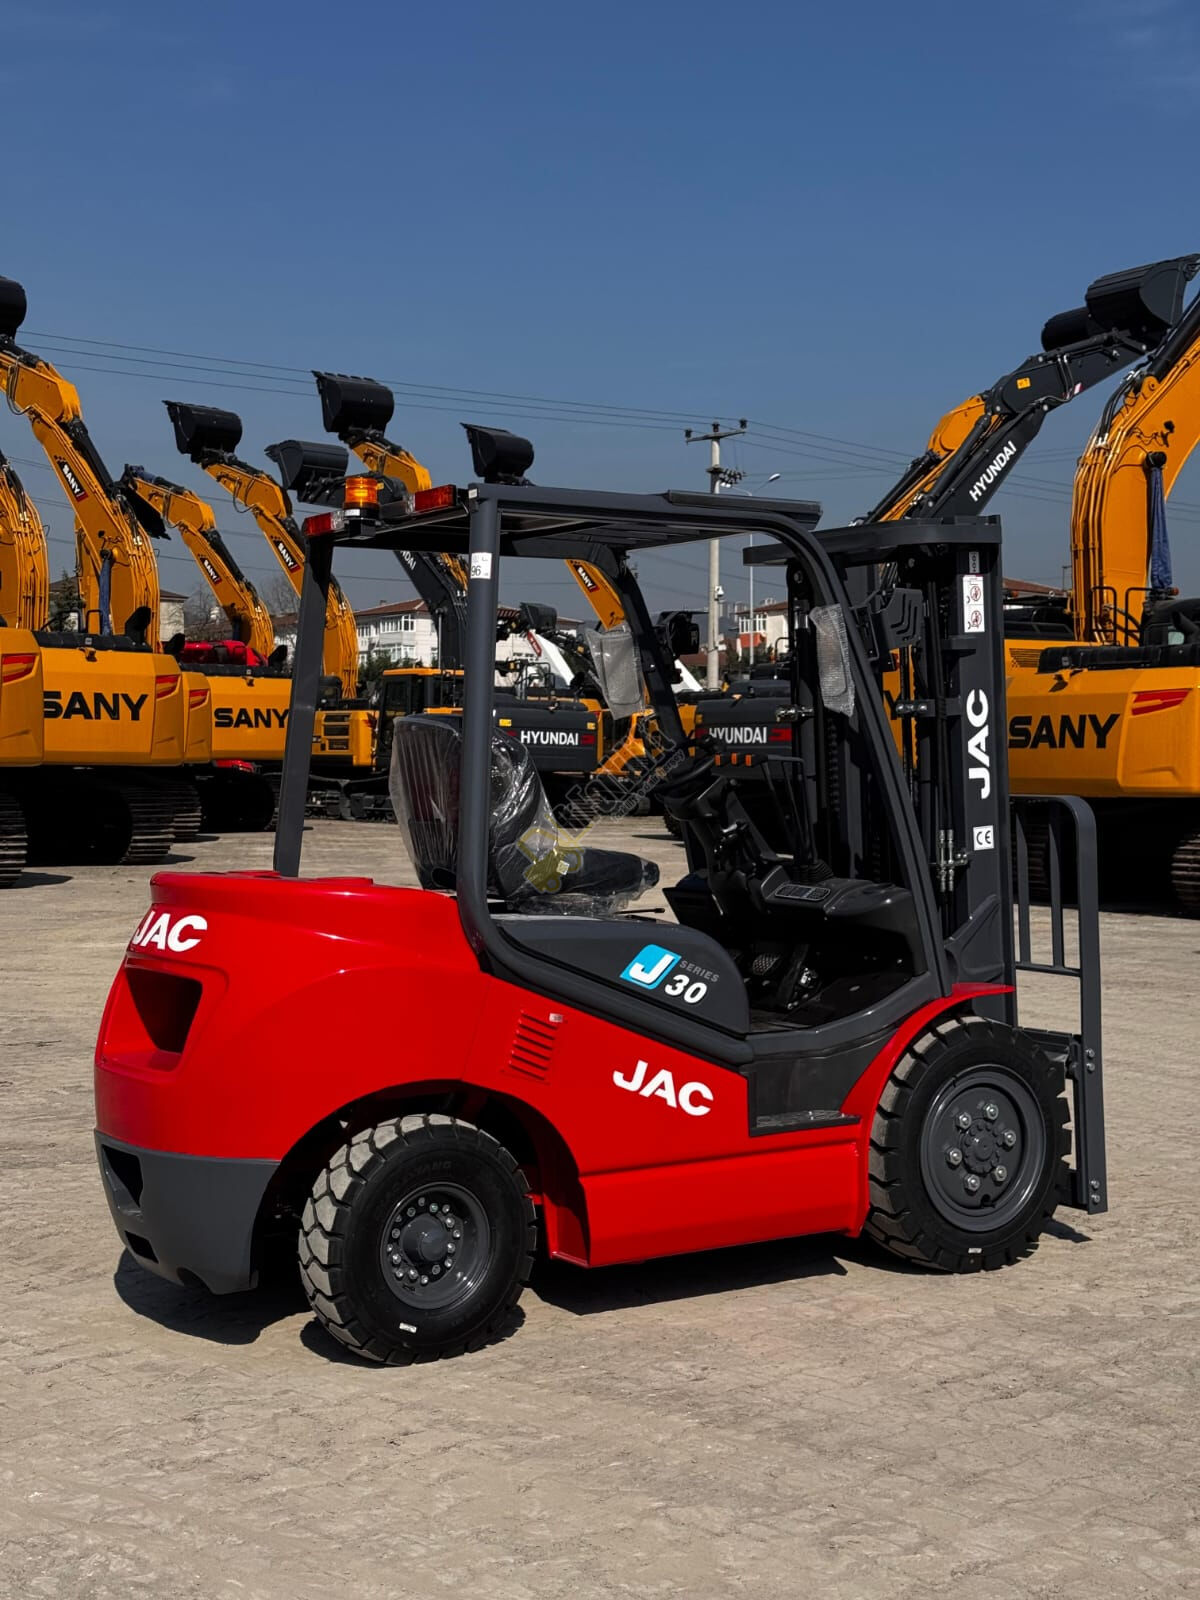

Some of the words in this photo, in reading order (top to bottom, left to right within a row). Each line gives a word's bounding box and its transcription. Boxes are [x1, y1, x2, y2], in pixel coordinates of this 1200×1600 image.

[969, 440, 1017, 502] HYUNDAI
[43, 691, 148, 721] SANY
[214, 708, 289, 728] SANY
[520, 730, 579, 746] HYUNDAI
[709, 727, 768, 744] HYUNDAI
[966, 689, 991, 800] JAC
[1008, 714, 1121, 749] SANY
[132, 910, 208, 952] JAC
[629, 953, 675, 984] J
[680, 960, 719, 982] SERIES
[664, 974, 708, 1003] 30
[612, 1059, 714, 1116] JAC
